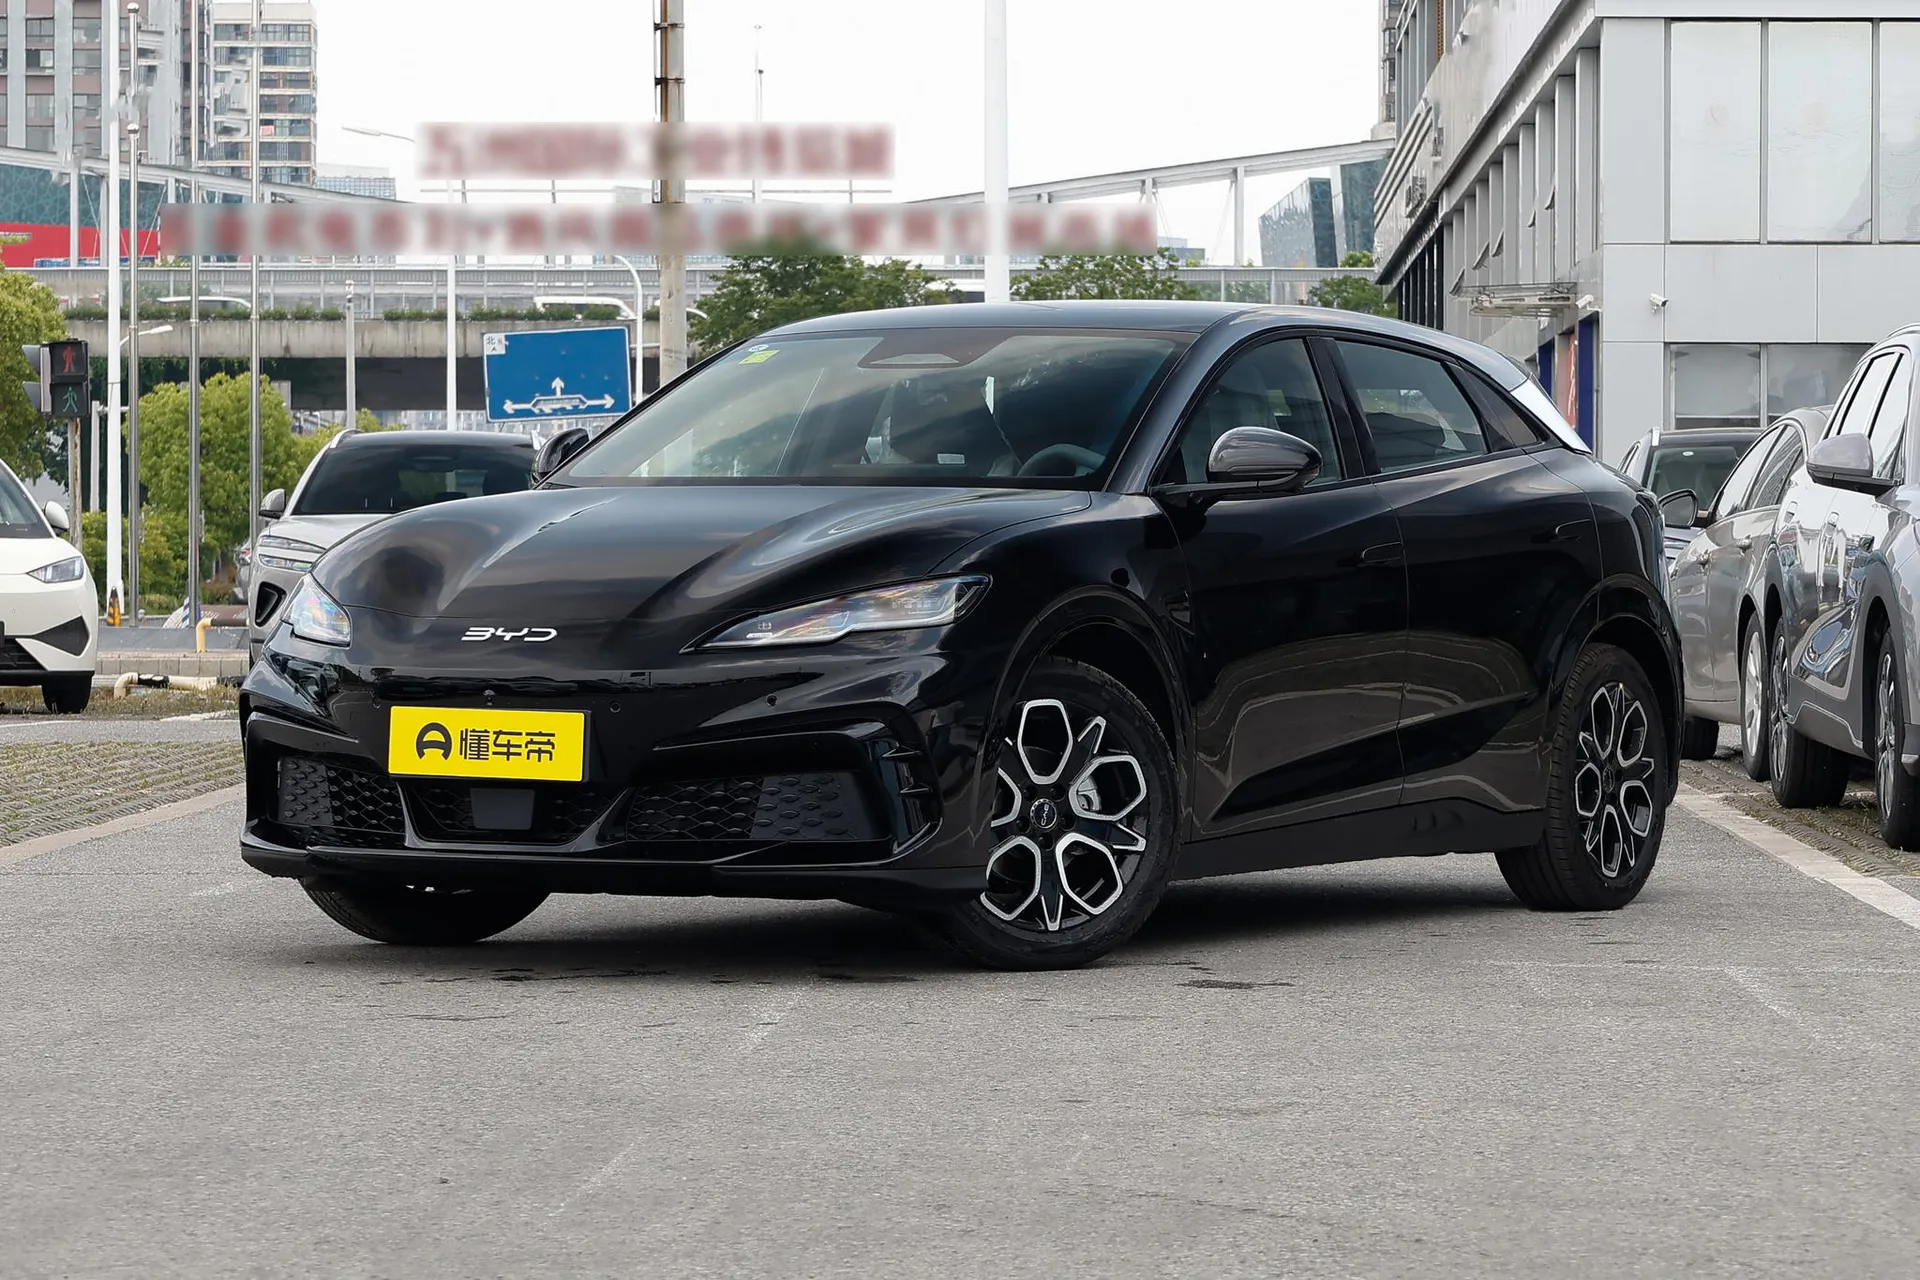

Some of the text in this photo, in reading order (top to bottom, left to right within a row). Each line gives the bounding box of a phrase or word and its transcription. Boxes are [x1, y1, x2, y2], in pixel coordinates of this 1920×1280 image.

[461, 627, 558, 642] BYD
[459, 728, 556, 763] 懂车帝
